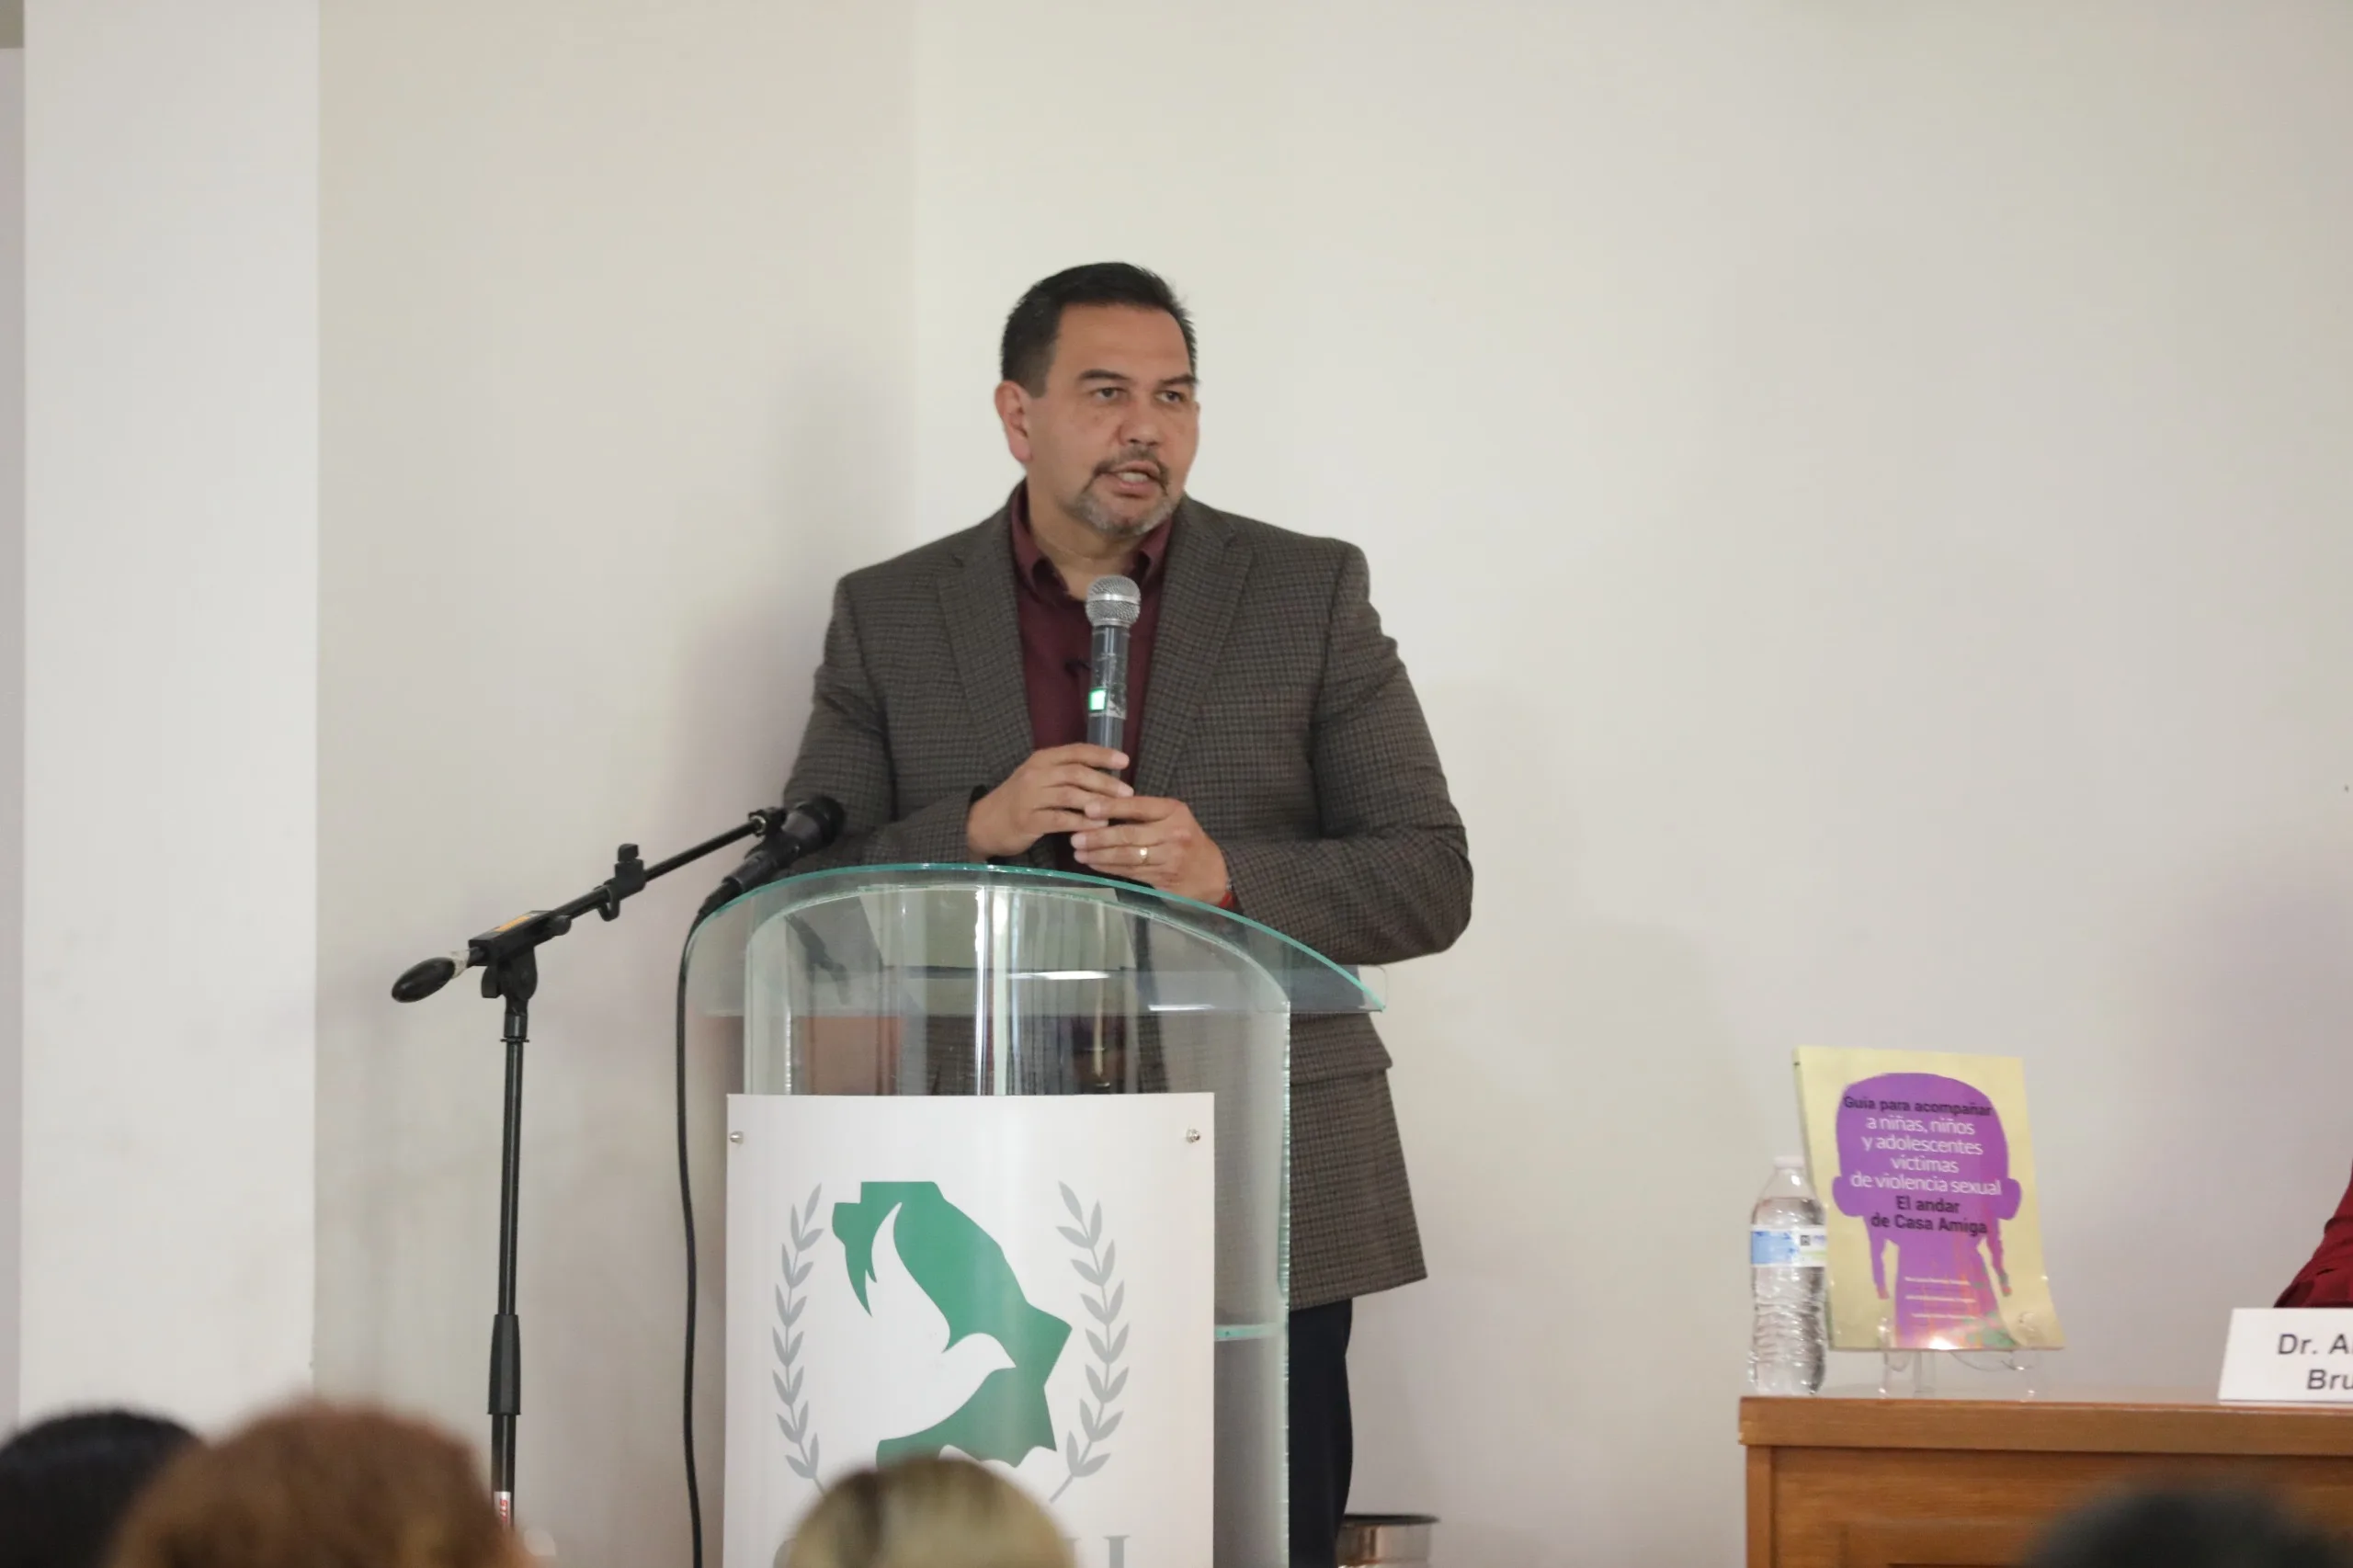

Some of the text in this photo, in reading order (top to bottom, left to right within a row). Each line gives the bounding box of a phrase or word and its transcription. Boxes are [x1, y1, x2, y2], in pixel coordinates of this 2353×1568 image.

[1880, 1100, 1911, 1113] para
[1866, 1114, 1975, 1136] a niñas, niños
[1861, 1134, 1984, 1155] y adolescentes
[1850, 1171, 2002, 1196] de violencia sexual
[1896, 1195, 1960, 1214] El andar
[1870, 1211, 1988, 1236] de Casa Amiga
[2278, 1333, 2353, 1355] Dr. A
